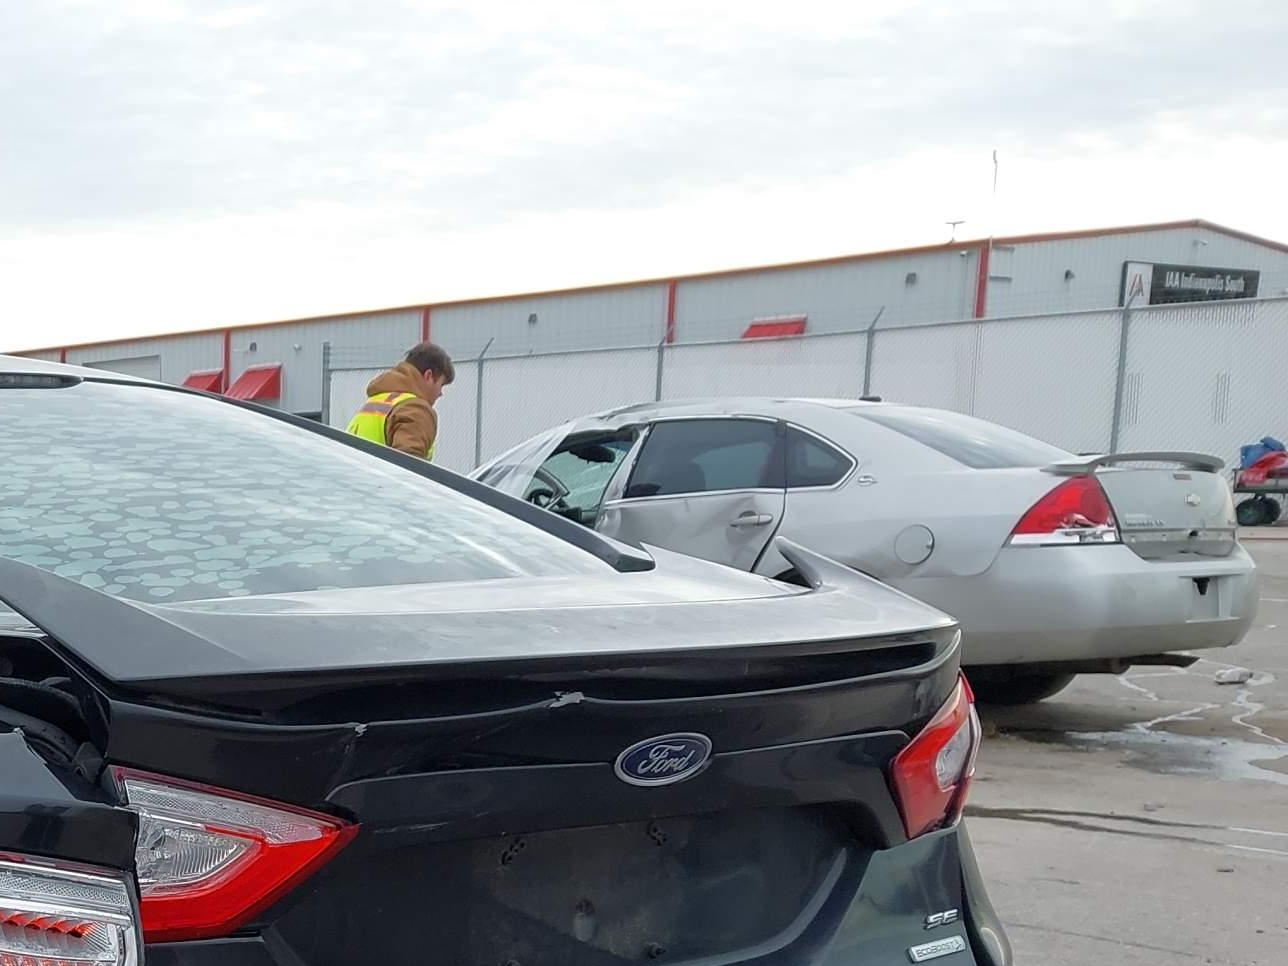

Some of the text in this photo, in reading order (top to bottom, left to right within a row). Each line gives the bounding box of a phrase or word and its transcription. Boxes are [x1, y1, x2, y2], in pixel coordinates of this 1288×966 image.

[1165, 271, 1180, 289] IAA
[637, 743, 696, 774] Ford
[926, 908, 959, 929] SE
